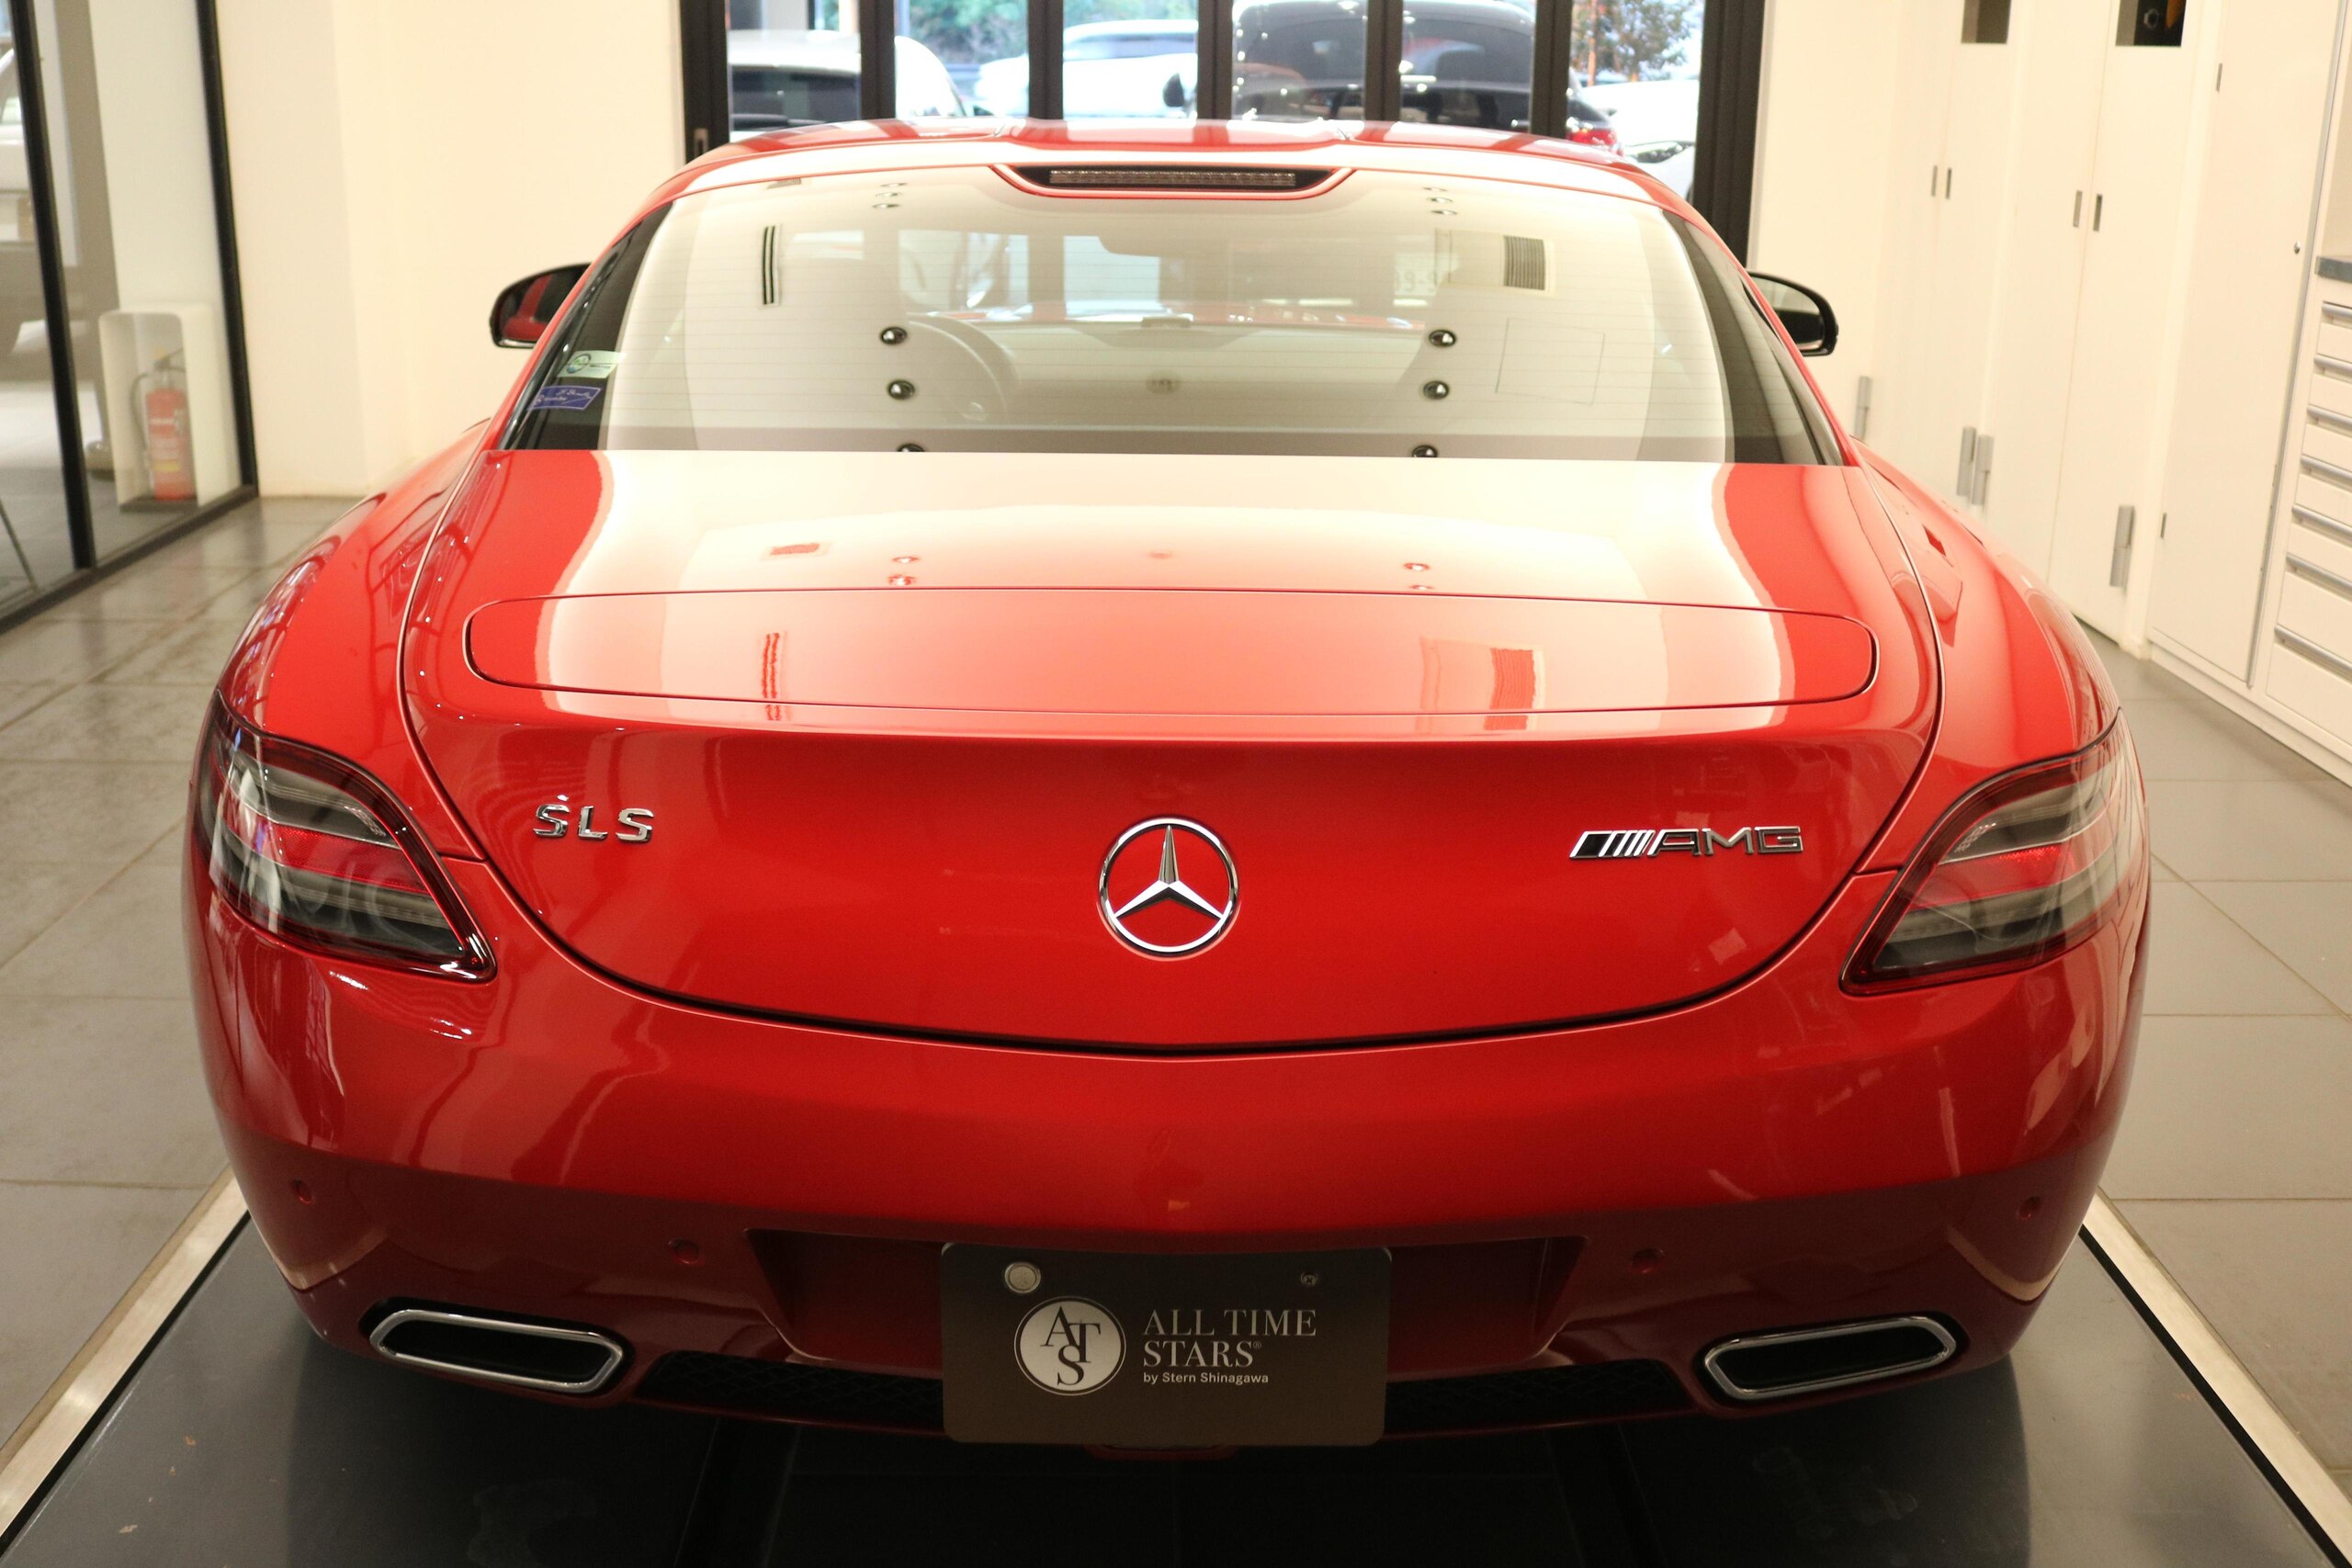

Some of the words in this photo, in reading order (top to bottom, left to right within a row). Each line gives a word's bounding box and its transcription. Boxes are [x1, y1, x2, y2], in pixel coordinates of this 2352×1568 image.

[532, 803, 655, 843] SLS
[1646, 825, 1804, 856] AMG
[1144, 1309, 1216, 1337] ALL
[1223, 1309, 1317, 1337] TIME
[1143, 1371, 1159, 1385] by
[1162, 1371, 1196, 1384] Stern
[1200, 1371, 1269, 1385] Shinagawa
